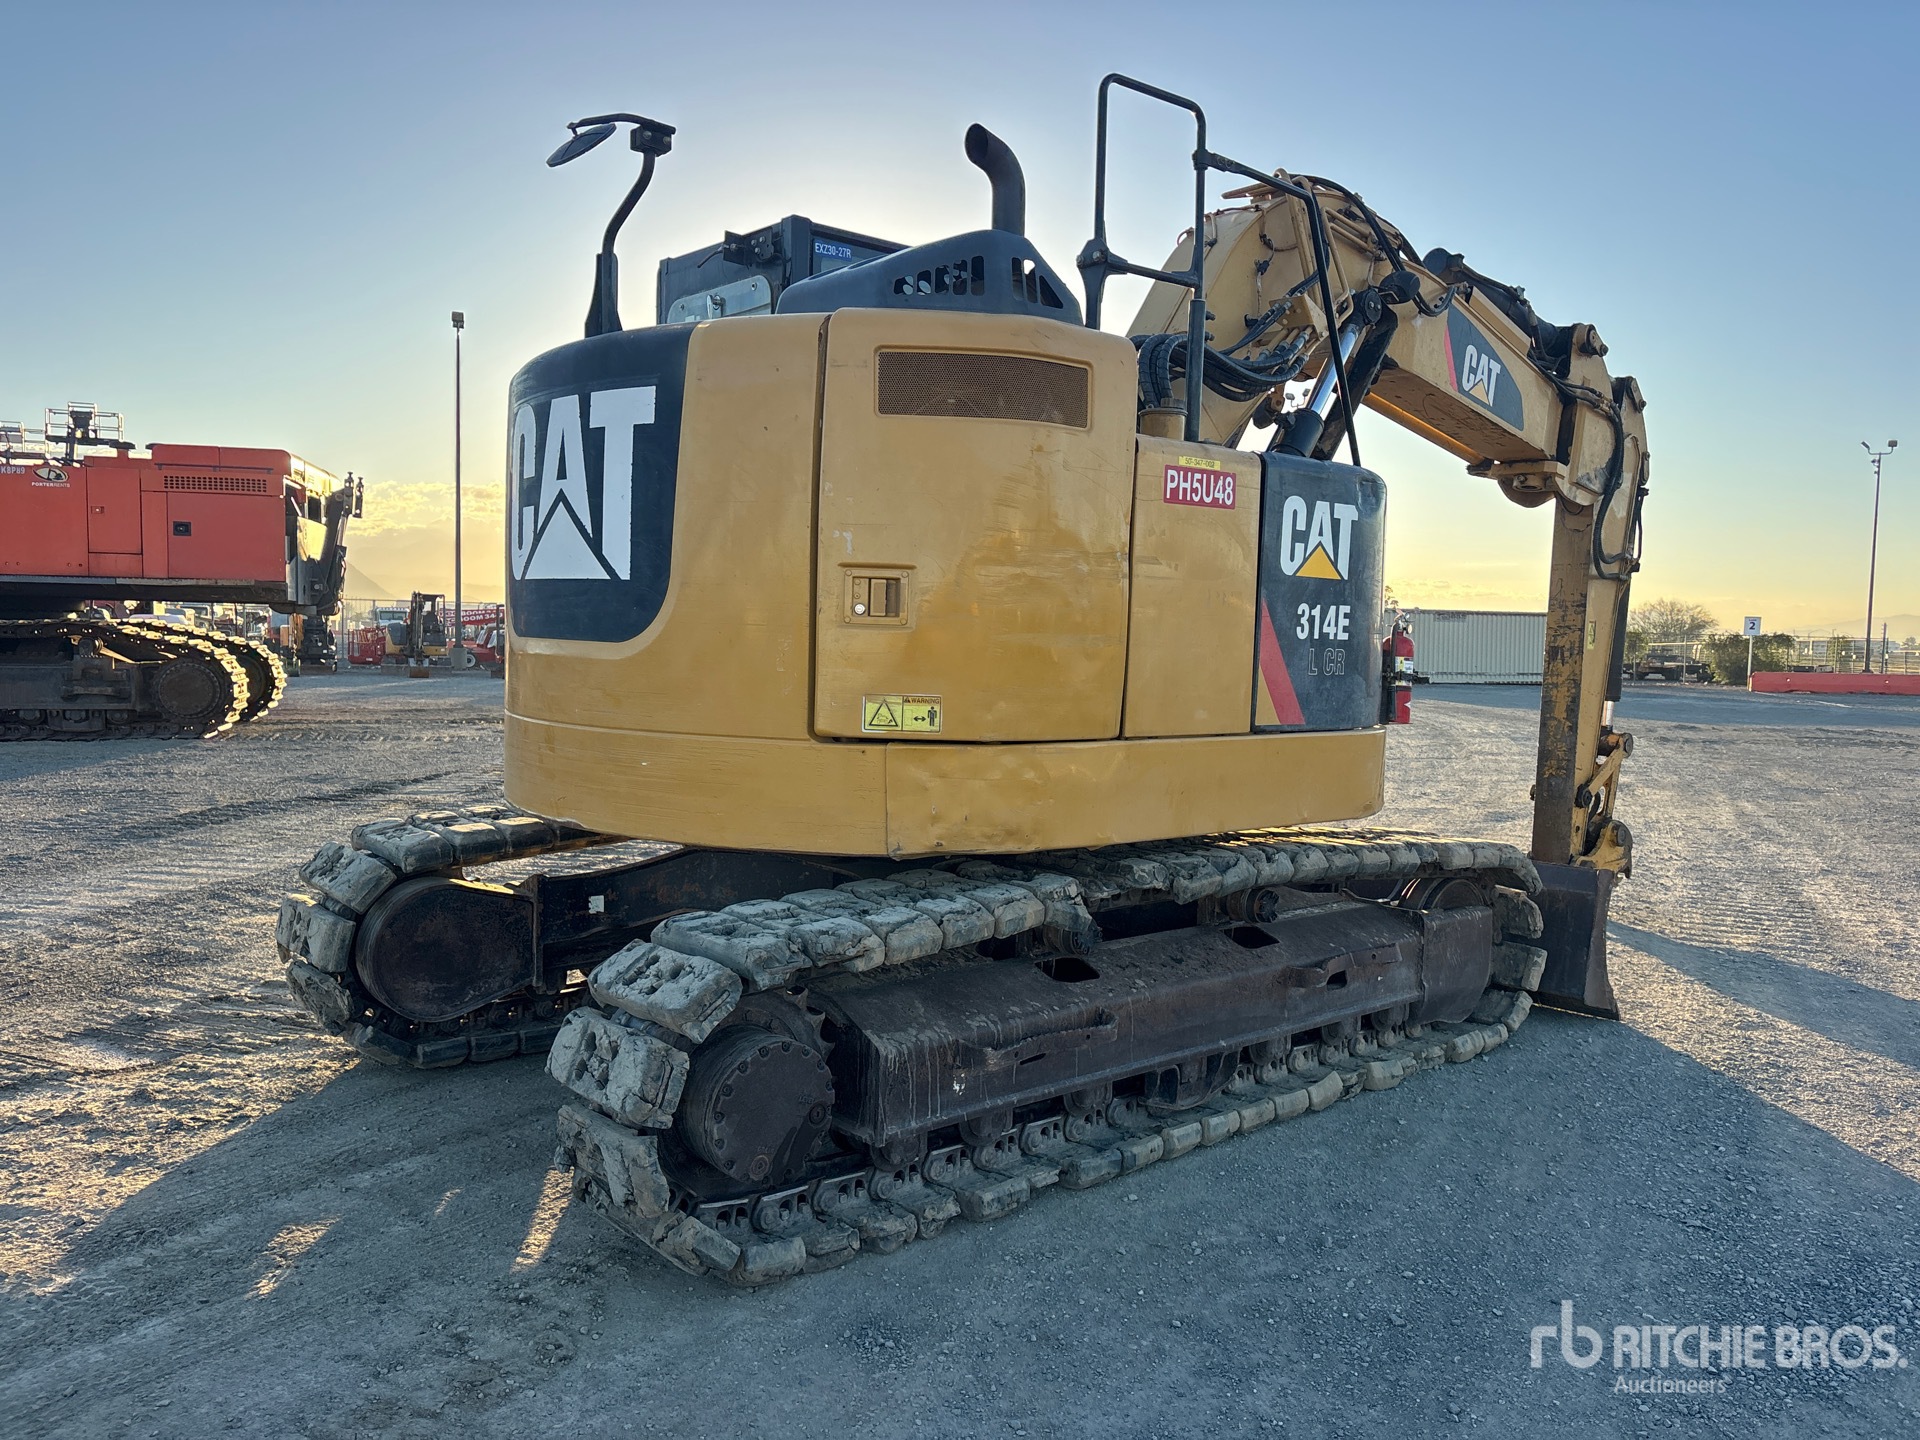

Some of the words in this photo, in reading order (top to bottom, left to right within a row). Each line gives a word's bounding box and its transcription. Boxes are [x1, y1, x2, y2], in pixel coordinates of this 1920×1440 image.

[814, 242, 852, 259] EXZ30-27R
[1462, 344, 1501, 407] CAT
[511, 385, 657, 581] CAT
[1166, 469, 1234, 506] PH5U48
[1280, 495, 1359, 580] CAT
[1296, 603, 1351, 640] 314E
[1749, 621, 1756, 630] 2
[1308, 648, 1318, 676] L
[1323, 648, 1346, 676] CR
